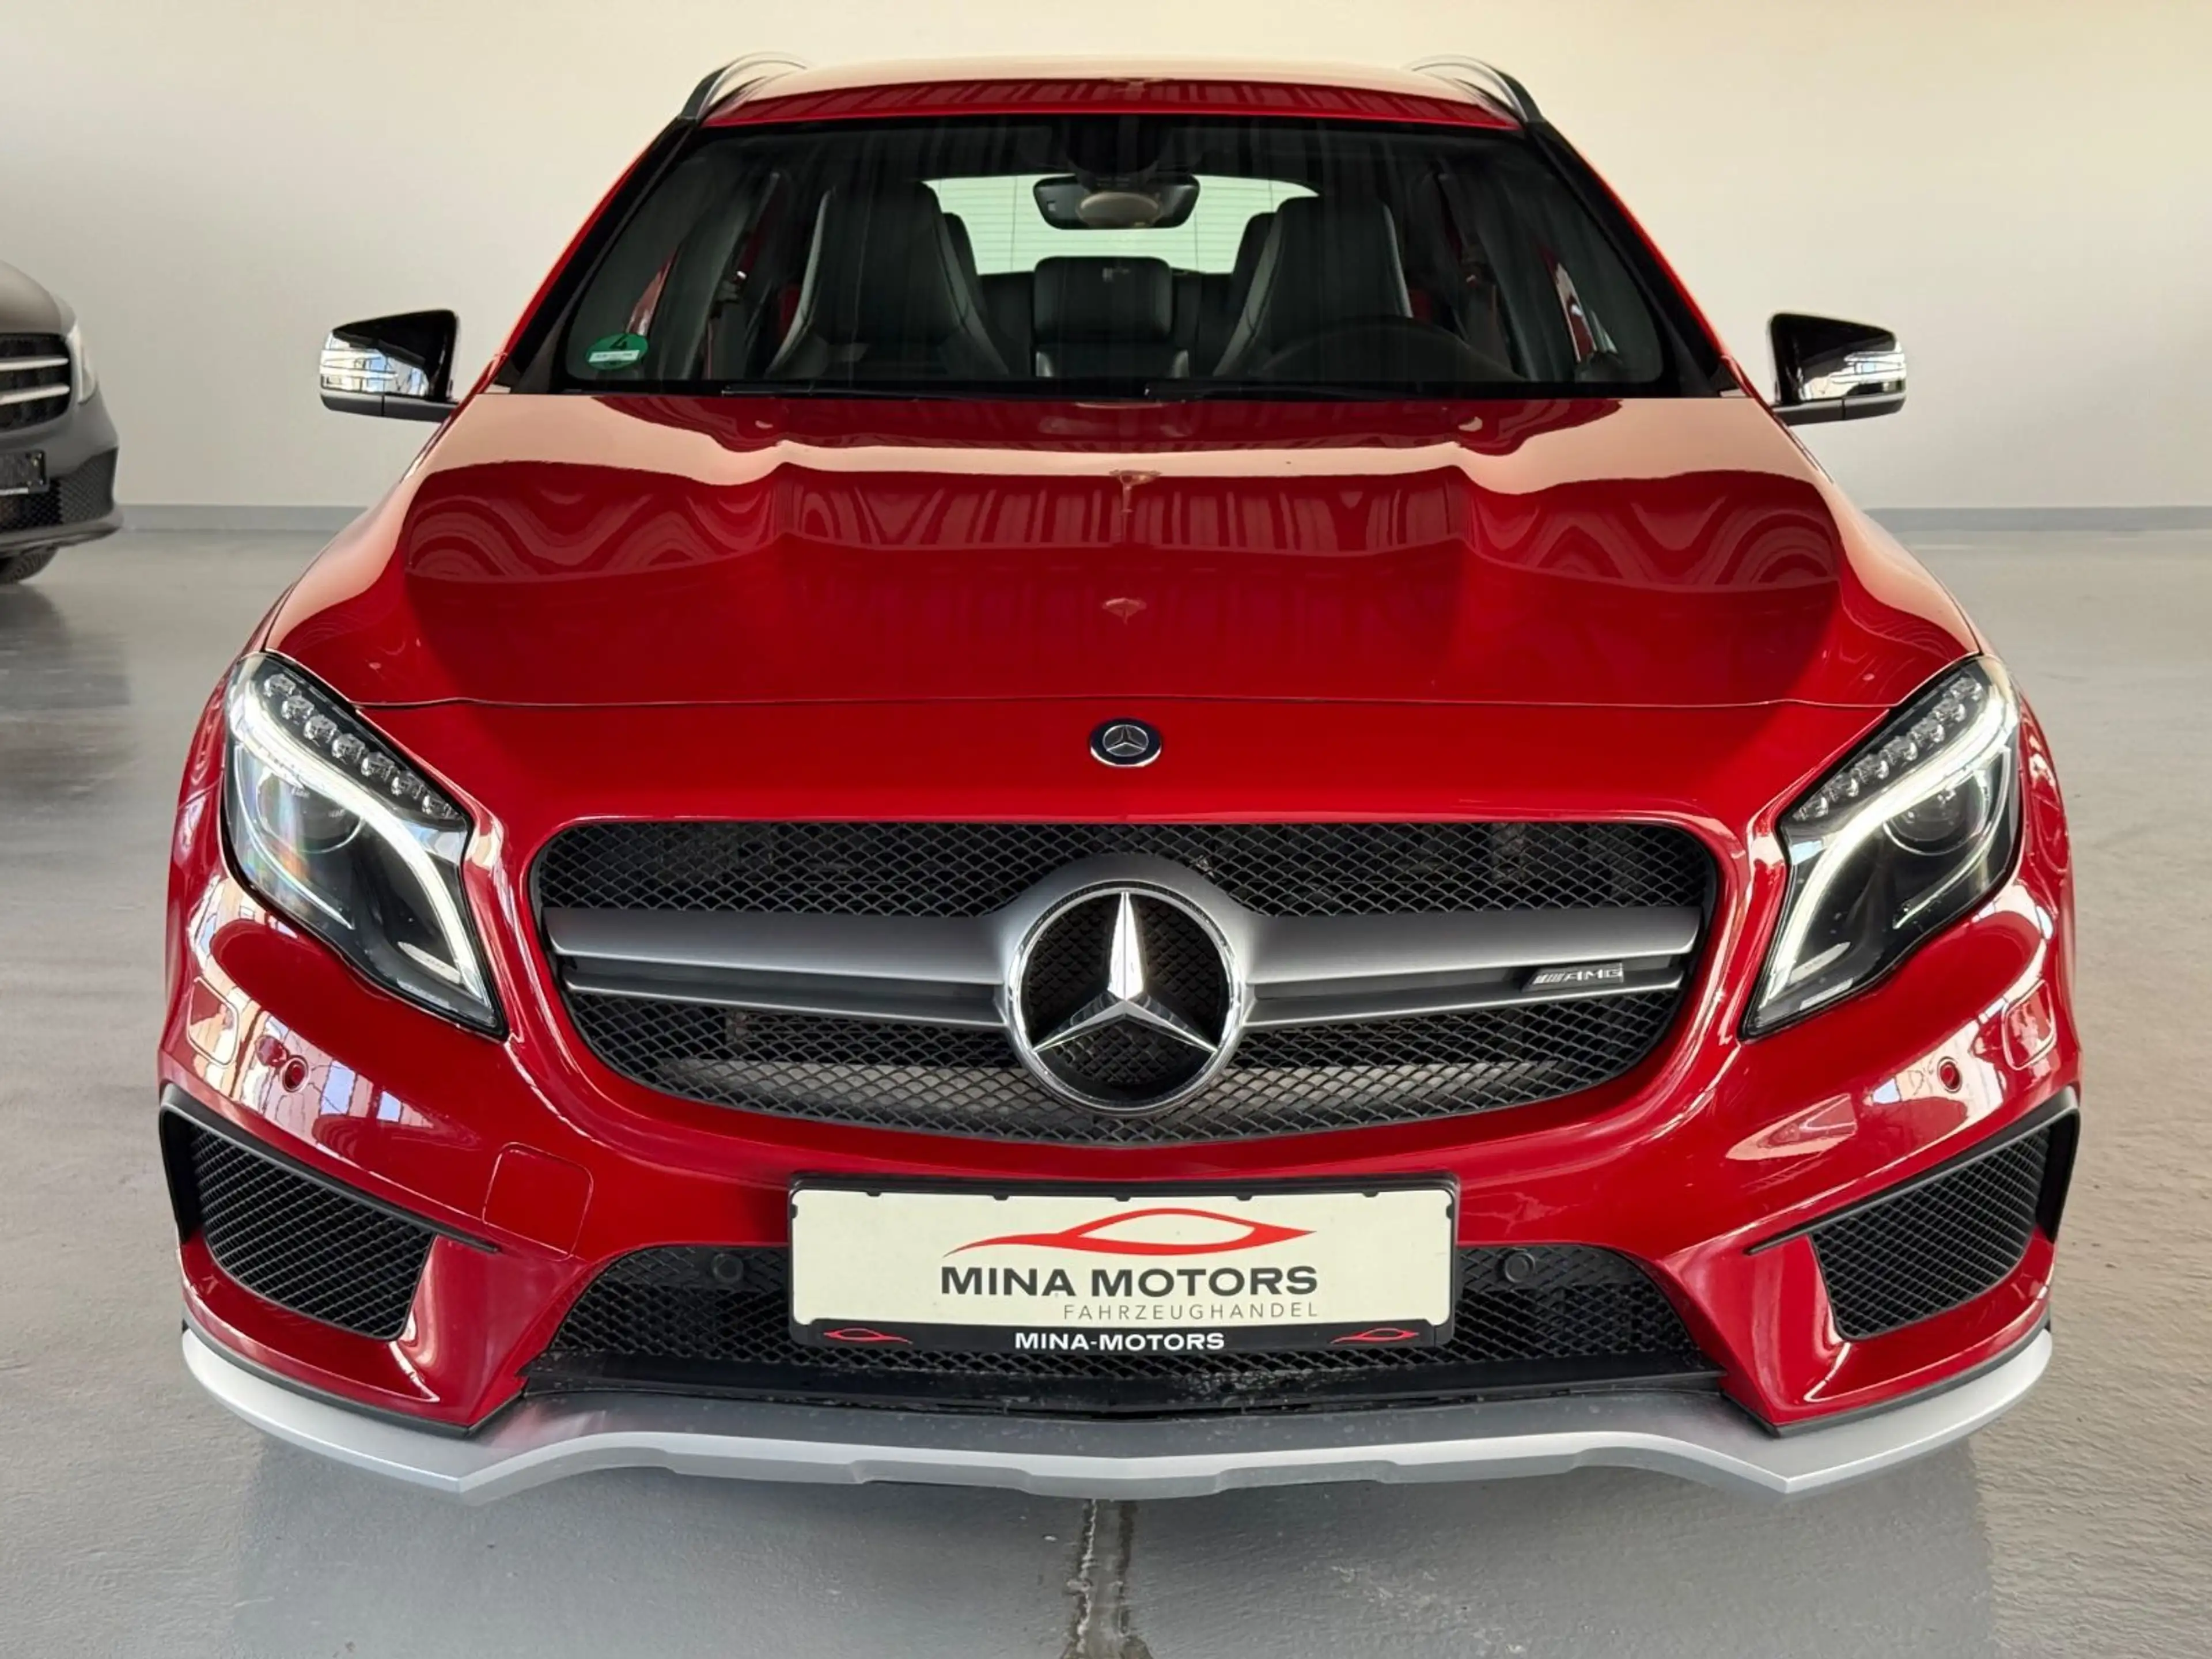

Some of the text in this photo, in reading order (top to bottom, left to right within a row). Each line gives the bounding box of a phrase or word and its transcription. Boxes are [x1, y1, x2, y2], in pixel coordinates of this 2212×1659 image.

[608, 333, 628, 350] 4
[1562, 969, 1623, 983] AMG
[942, 1266, 1317, 1297] MINA MOTORS
[1064, 1302, 1319, 1320] FAHRZEUGHANDEL
[1015, 1332, 1225, 1351] MINA-MOTORS
